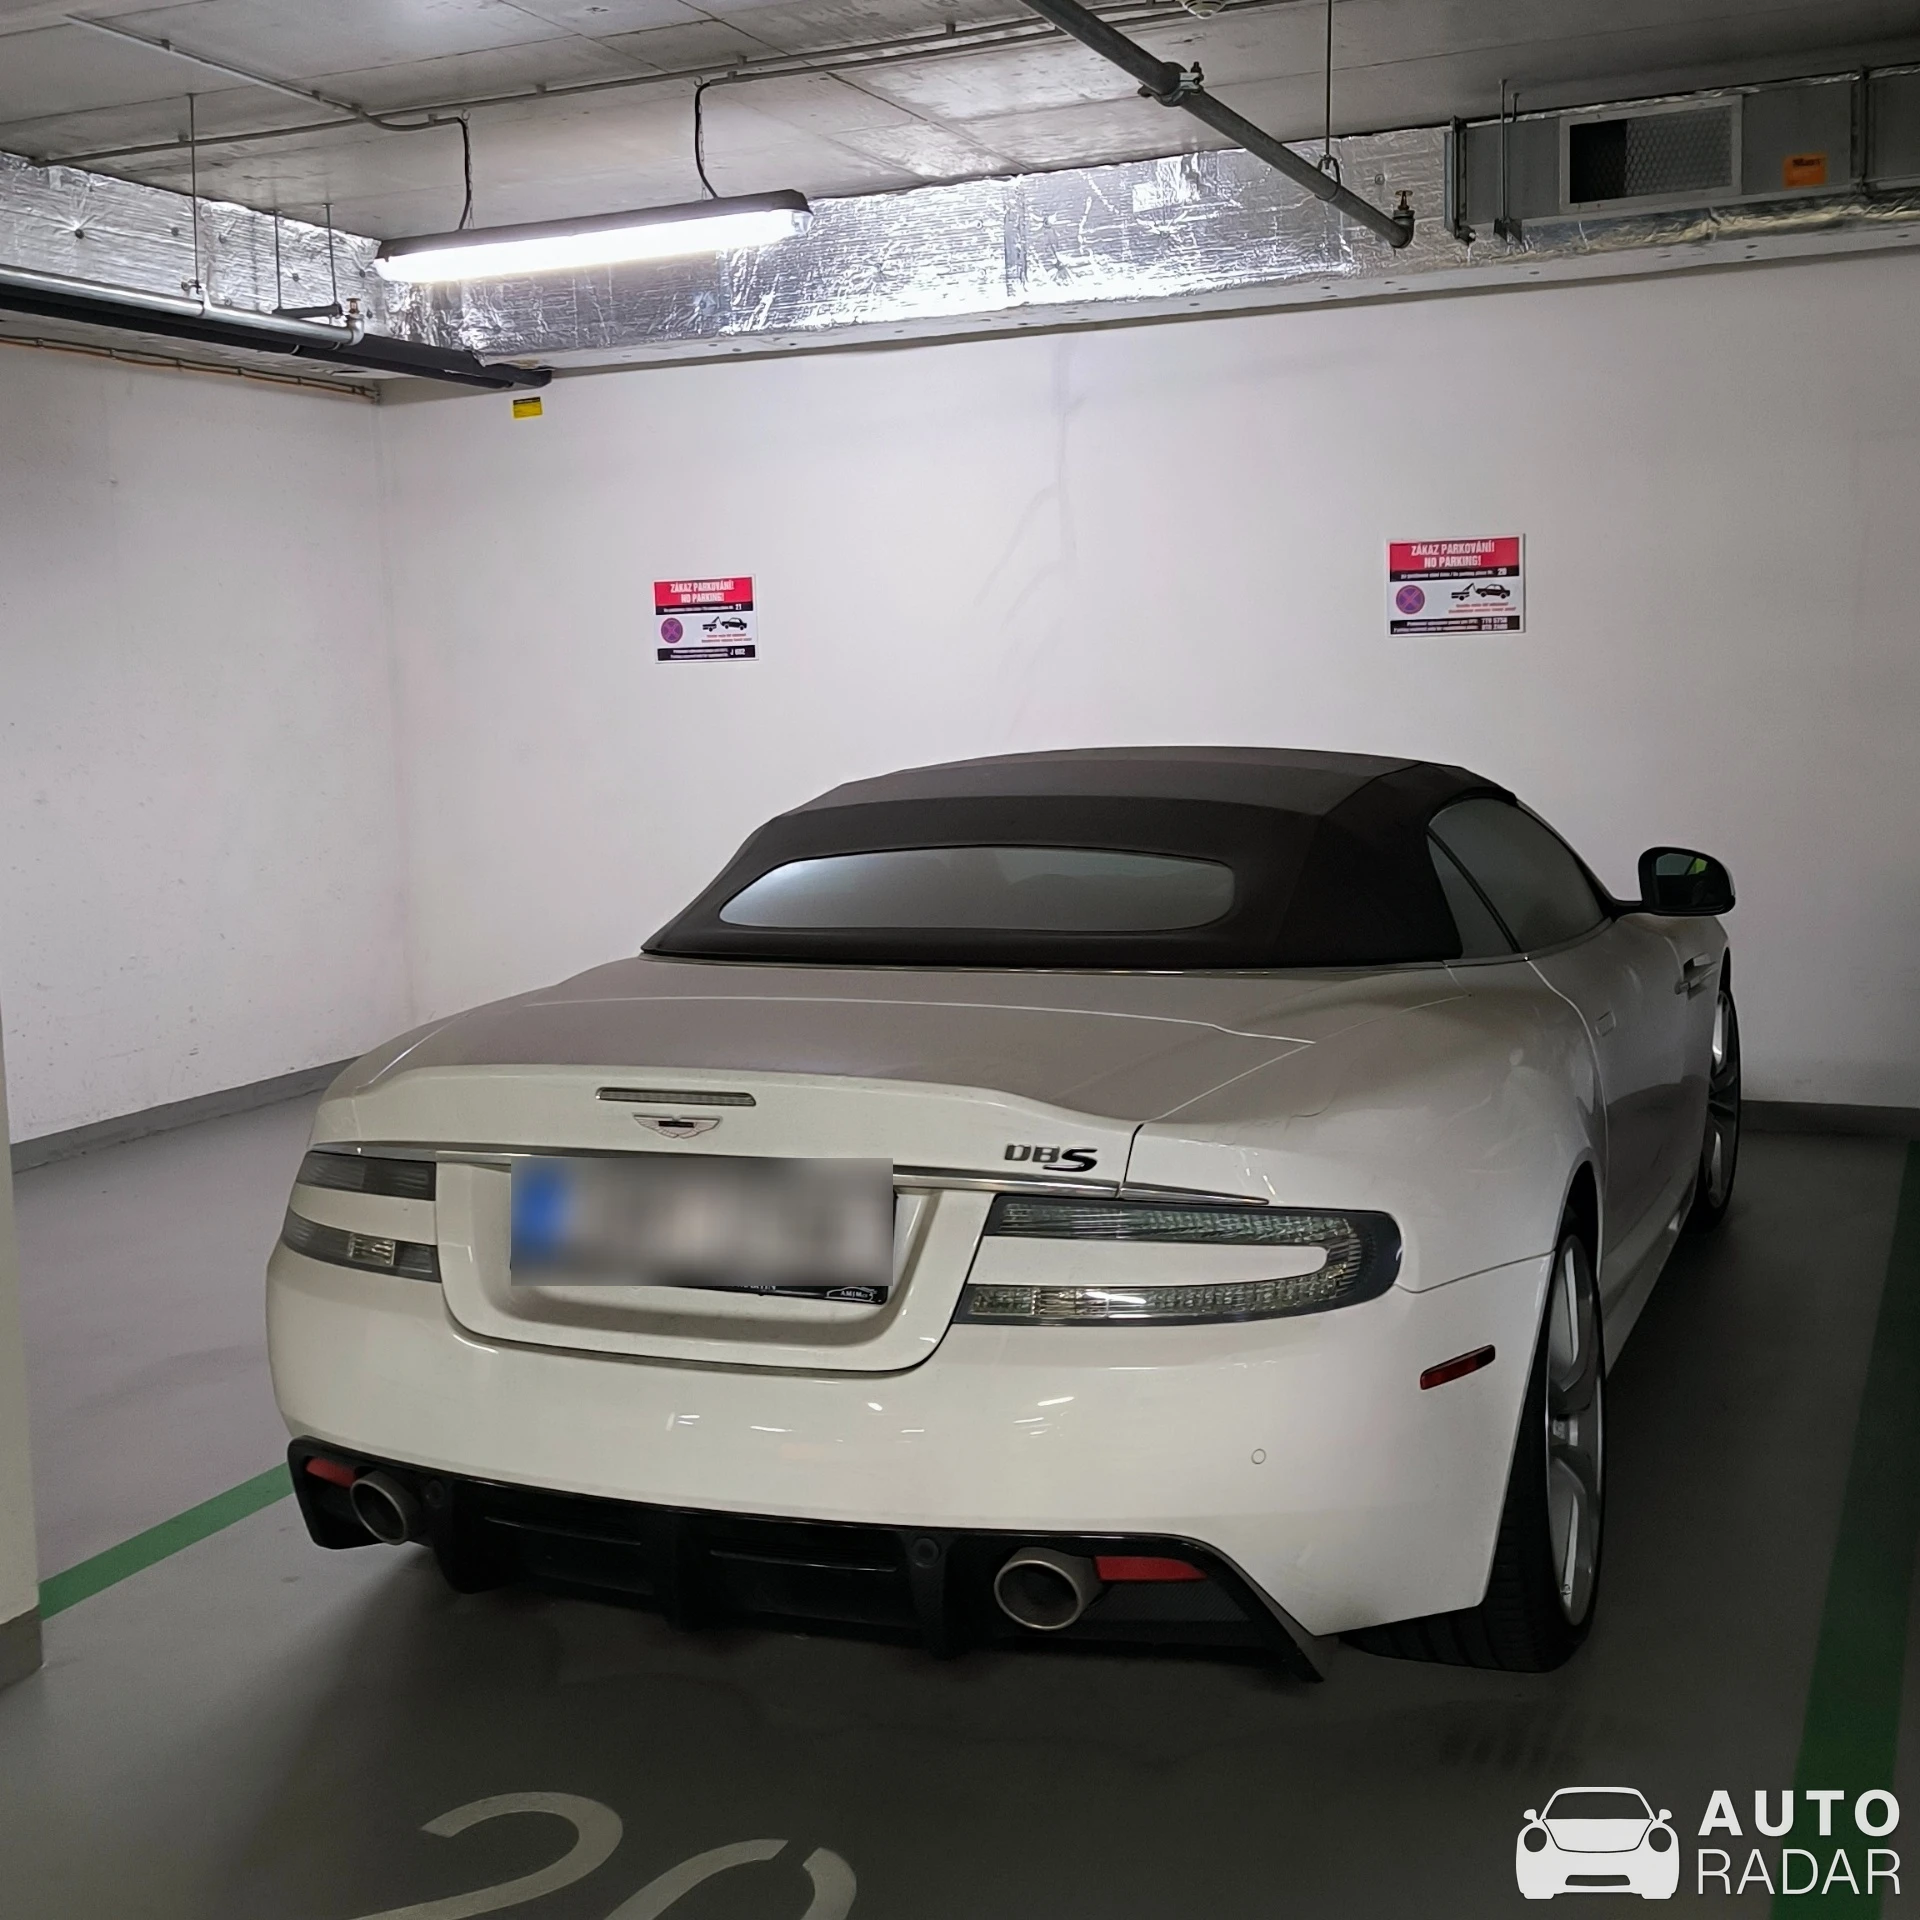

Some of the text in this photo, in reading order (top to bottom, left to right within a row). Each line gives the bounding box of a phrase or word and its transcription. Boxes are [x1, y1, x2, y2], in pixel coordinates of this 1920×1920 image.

[1411, 540, 1495, 556] ZÁKAZ PARKOVÁNÍ!
[1424, 555, 1482, 568] NO PARKING!
[670, 582, 692, 593] ZÁKAZ
[681, 593, 691, 603] NO
[1004, 1143, 1098, 1172] DBS
